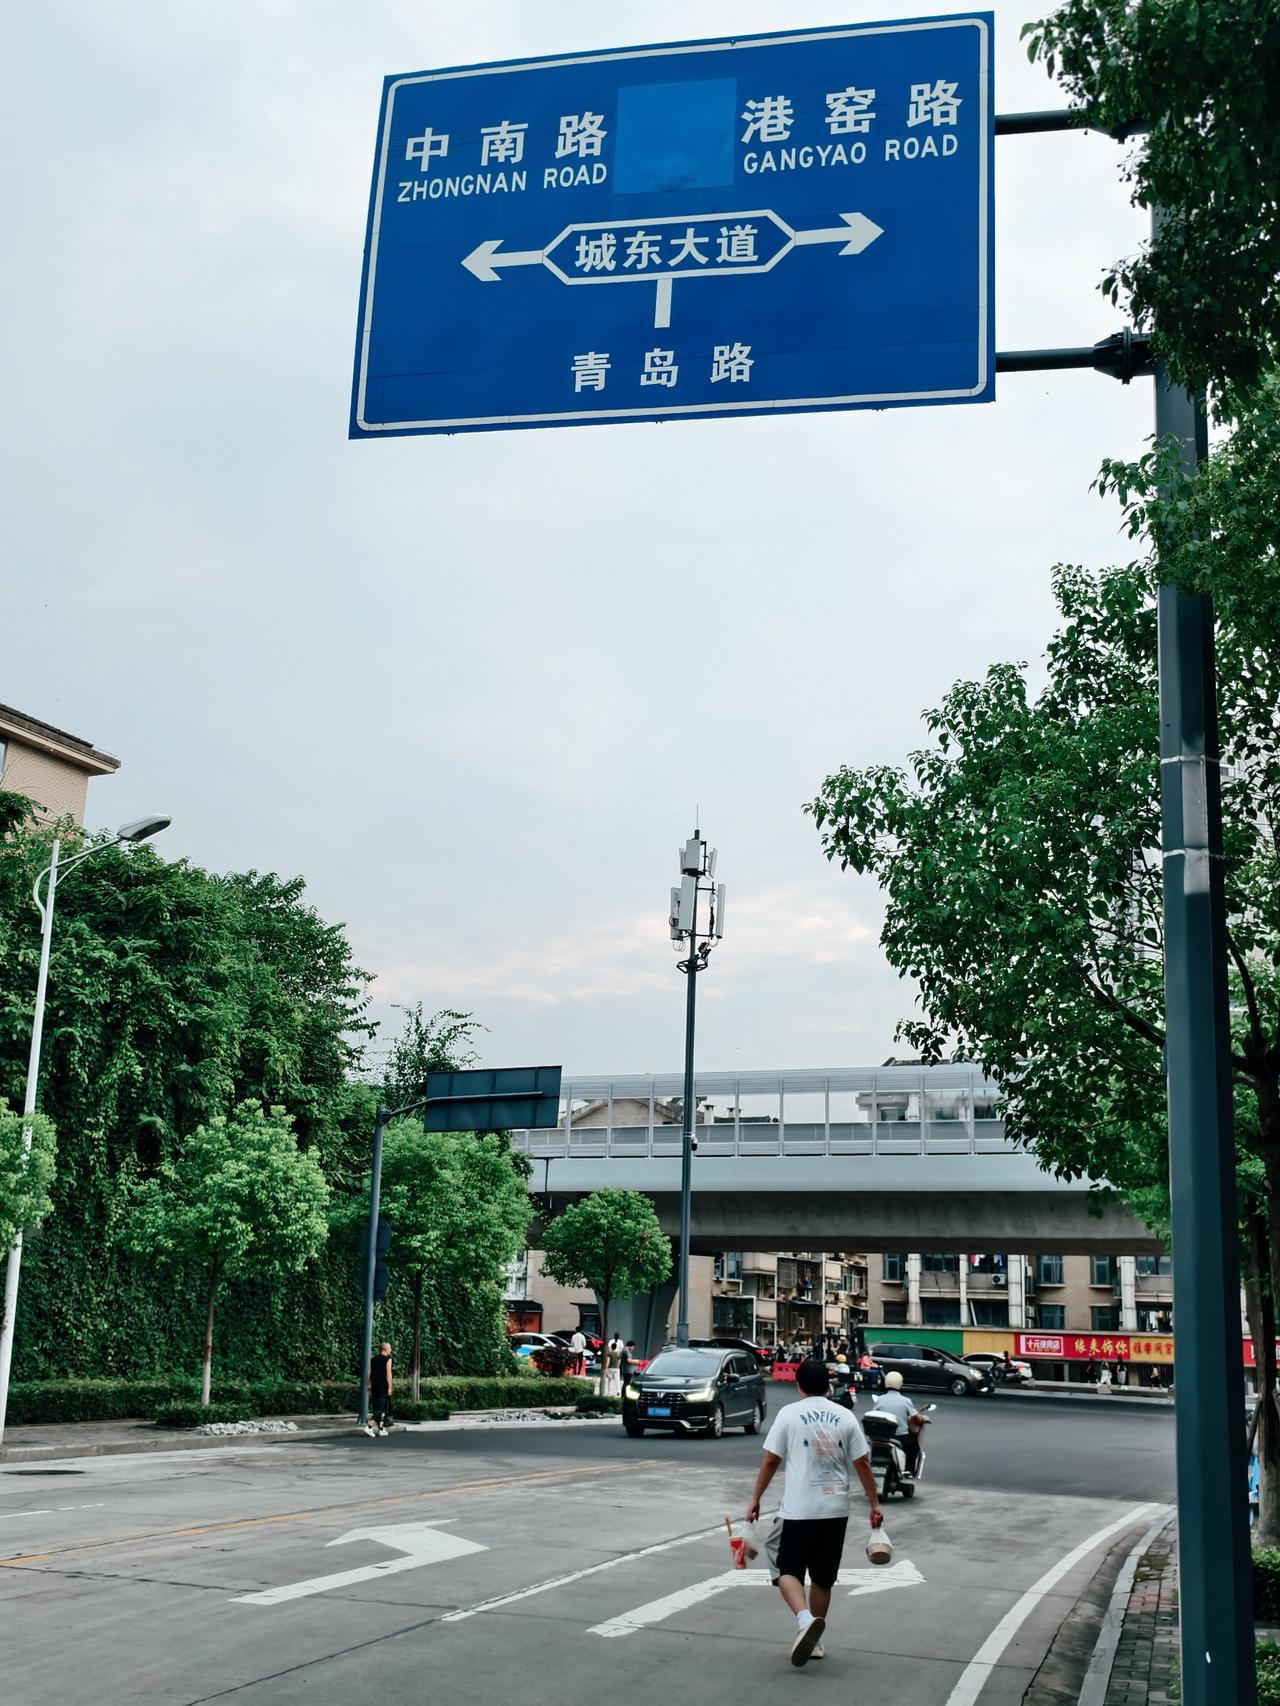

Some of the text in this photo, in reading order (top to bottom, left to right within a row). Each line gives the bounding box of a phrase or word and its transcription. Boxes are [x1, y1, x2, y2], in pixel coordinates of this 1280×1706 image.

[741, 80, 963, 144] 港窑路
[405, 111, 608, 172] 中南路
[743, 134, 959, 174] GANGYAO ROAD
[397, 163, 608, 203] ZHONGNAN ROAD
[575, 224, 760, 273] 城东大道
[571, 342, 755, 393] 青岛路
